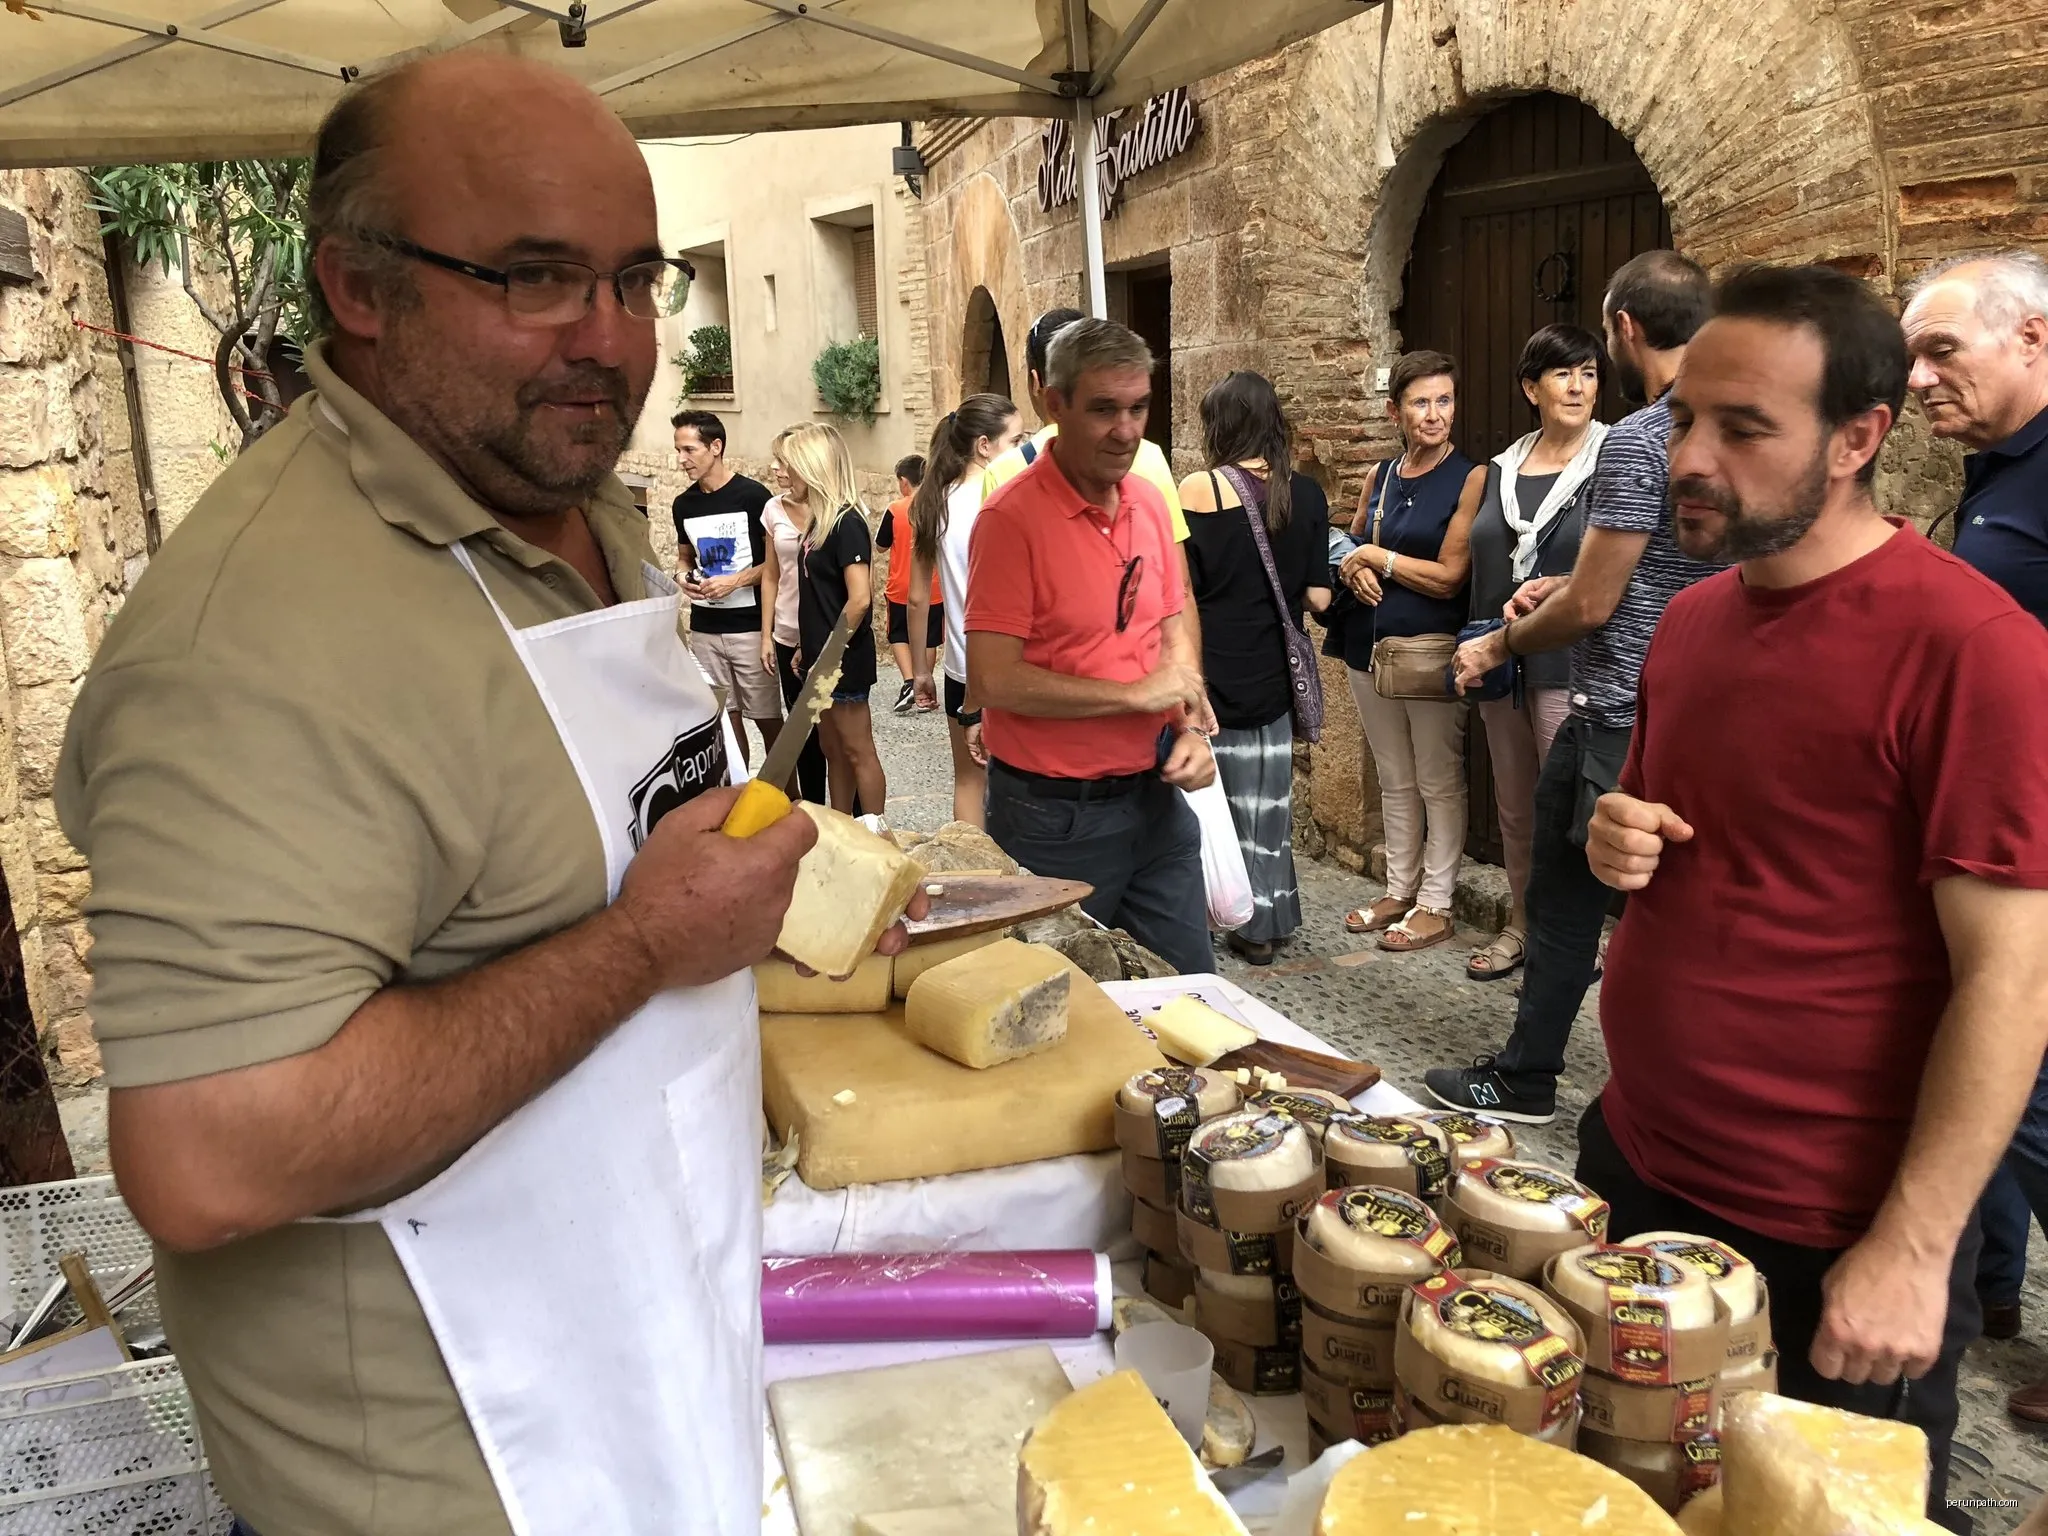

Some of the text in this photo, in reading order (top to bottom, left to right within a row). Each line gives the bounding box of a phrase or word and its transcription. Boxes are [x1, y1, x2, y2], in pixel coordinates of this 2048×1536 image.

[1469, 1083, 1500, 1105] N
[1346, 1192, 1424, 1235] Guara
[1461, 1222, 1504, 1255] Guara
[1681, 1251, 1724, 1266] ara
[1364, 1285, 1400, 1306] Gua
[1454, 1289, 1533, 1340] Guara
[1326, 1337, 1372, 1366] Guara
[1353, 1391, 1392, 1409] Guar
[1443, 1378, 1498, 1415] Guara
[1584, 1401, 1608, 1421] ara
[1685, 1441, 1721, 1462] Guar
